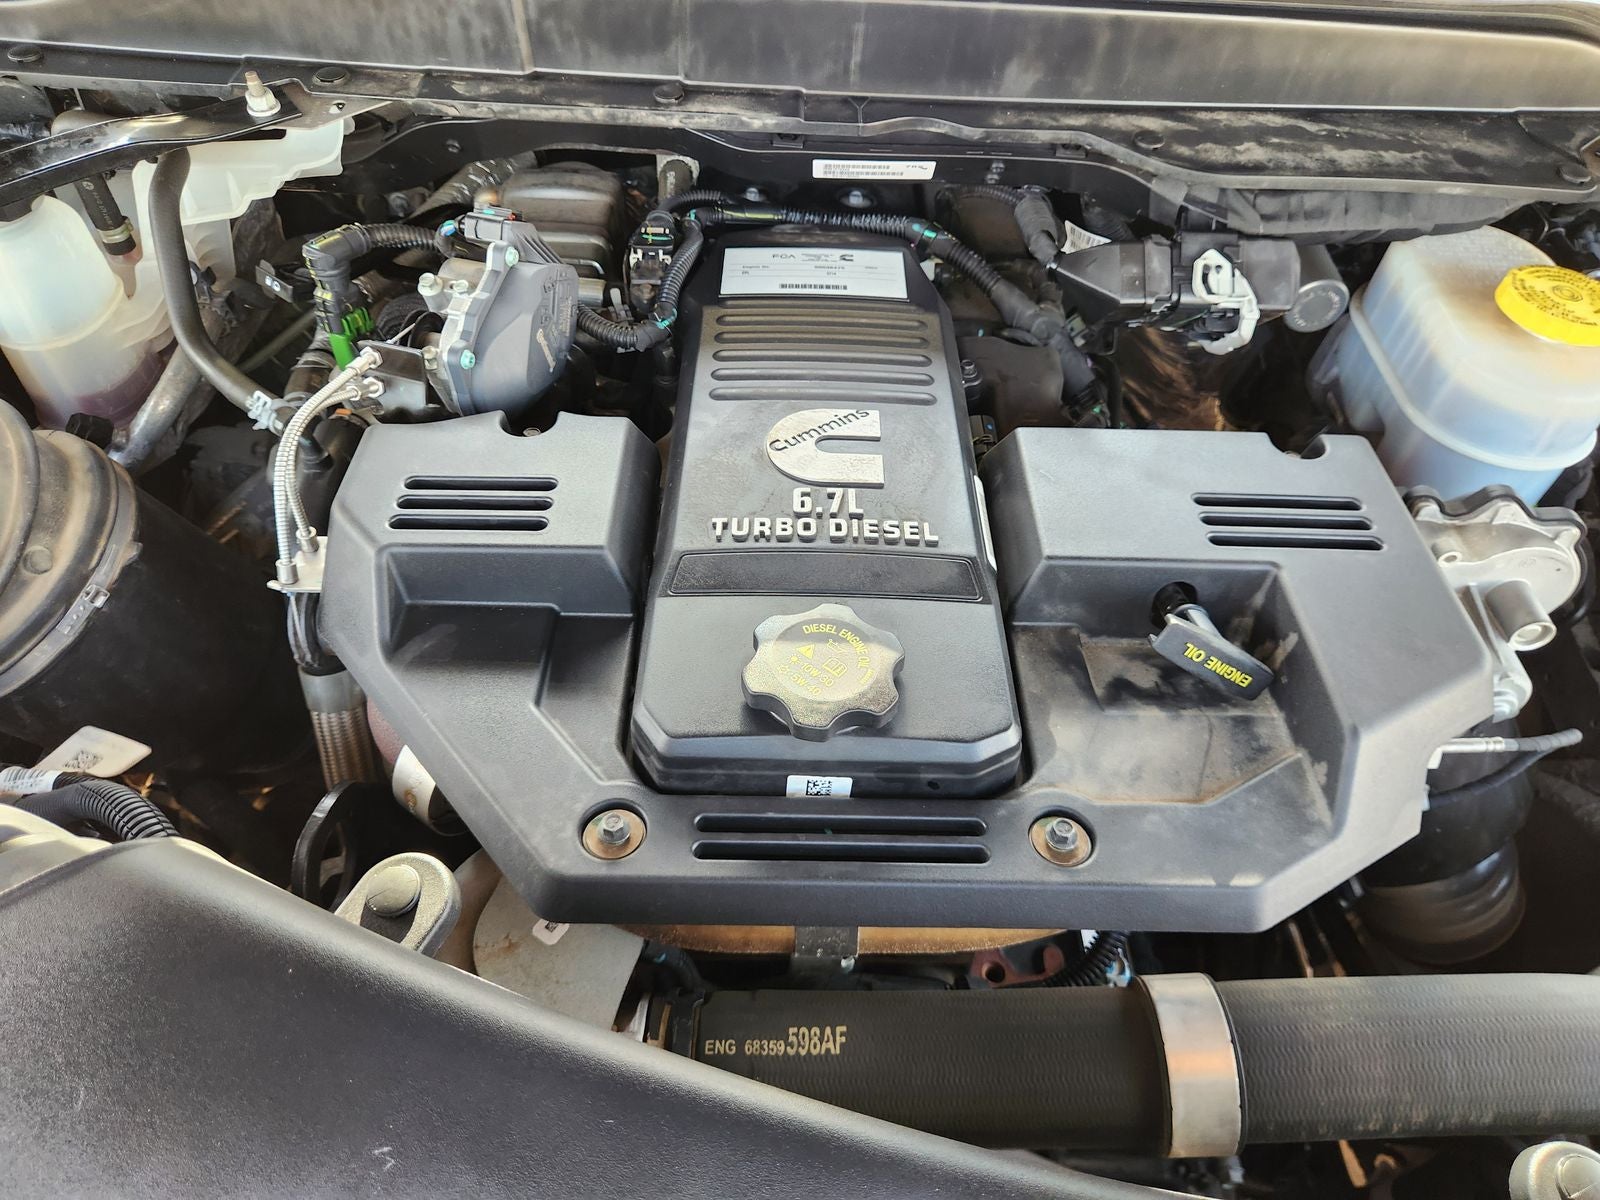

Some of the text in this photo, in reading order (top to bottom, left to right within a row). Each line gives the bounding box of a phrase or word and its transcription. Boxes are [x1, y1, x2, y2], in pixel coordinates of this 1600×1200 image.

[768, 408, 871, 452] Cummins
[792, 487, 864, 519] 6.7L
[712, 517, 940, 548] TURBO DIESEL
[802, 623, 838, 635] DIESEL
[838, 628, 870, 656] ENGINE
[1183, 641, 1253, 688] ENGINE OIL
[704, 1039, 737, 1056] ENG
